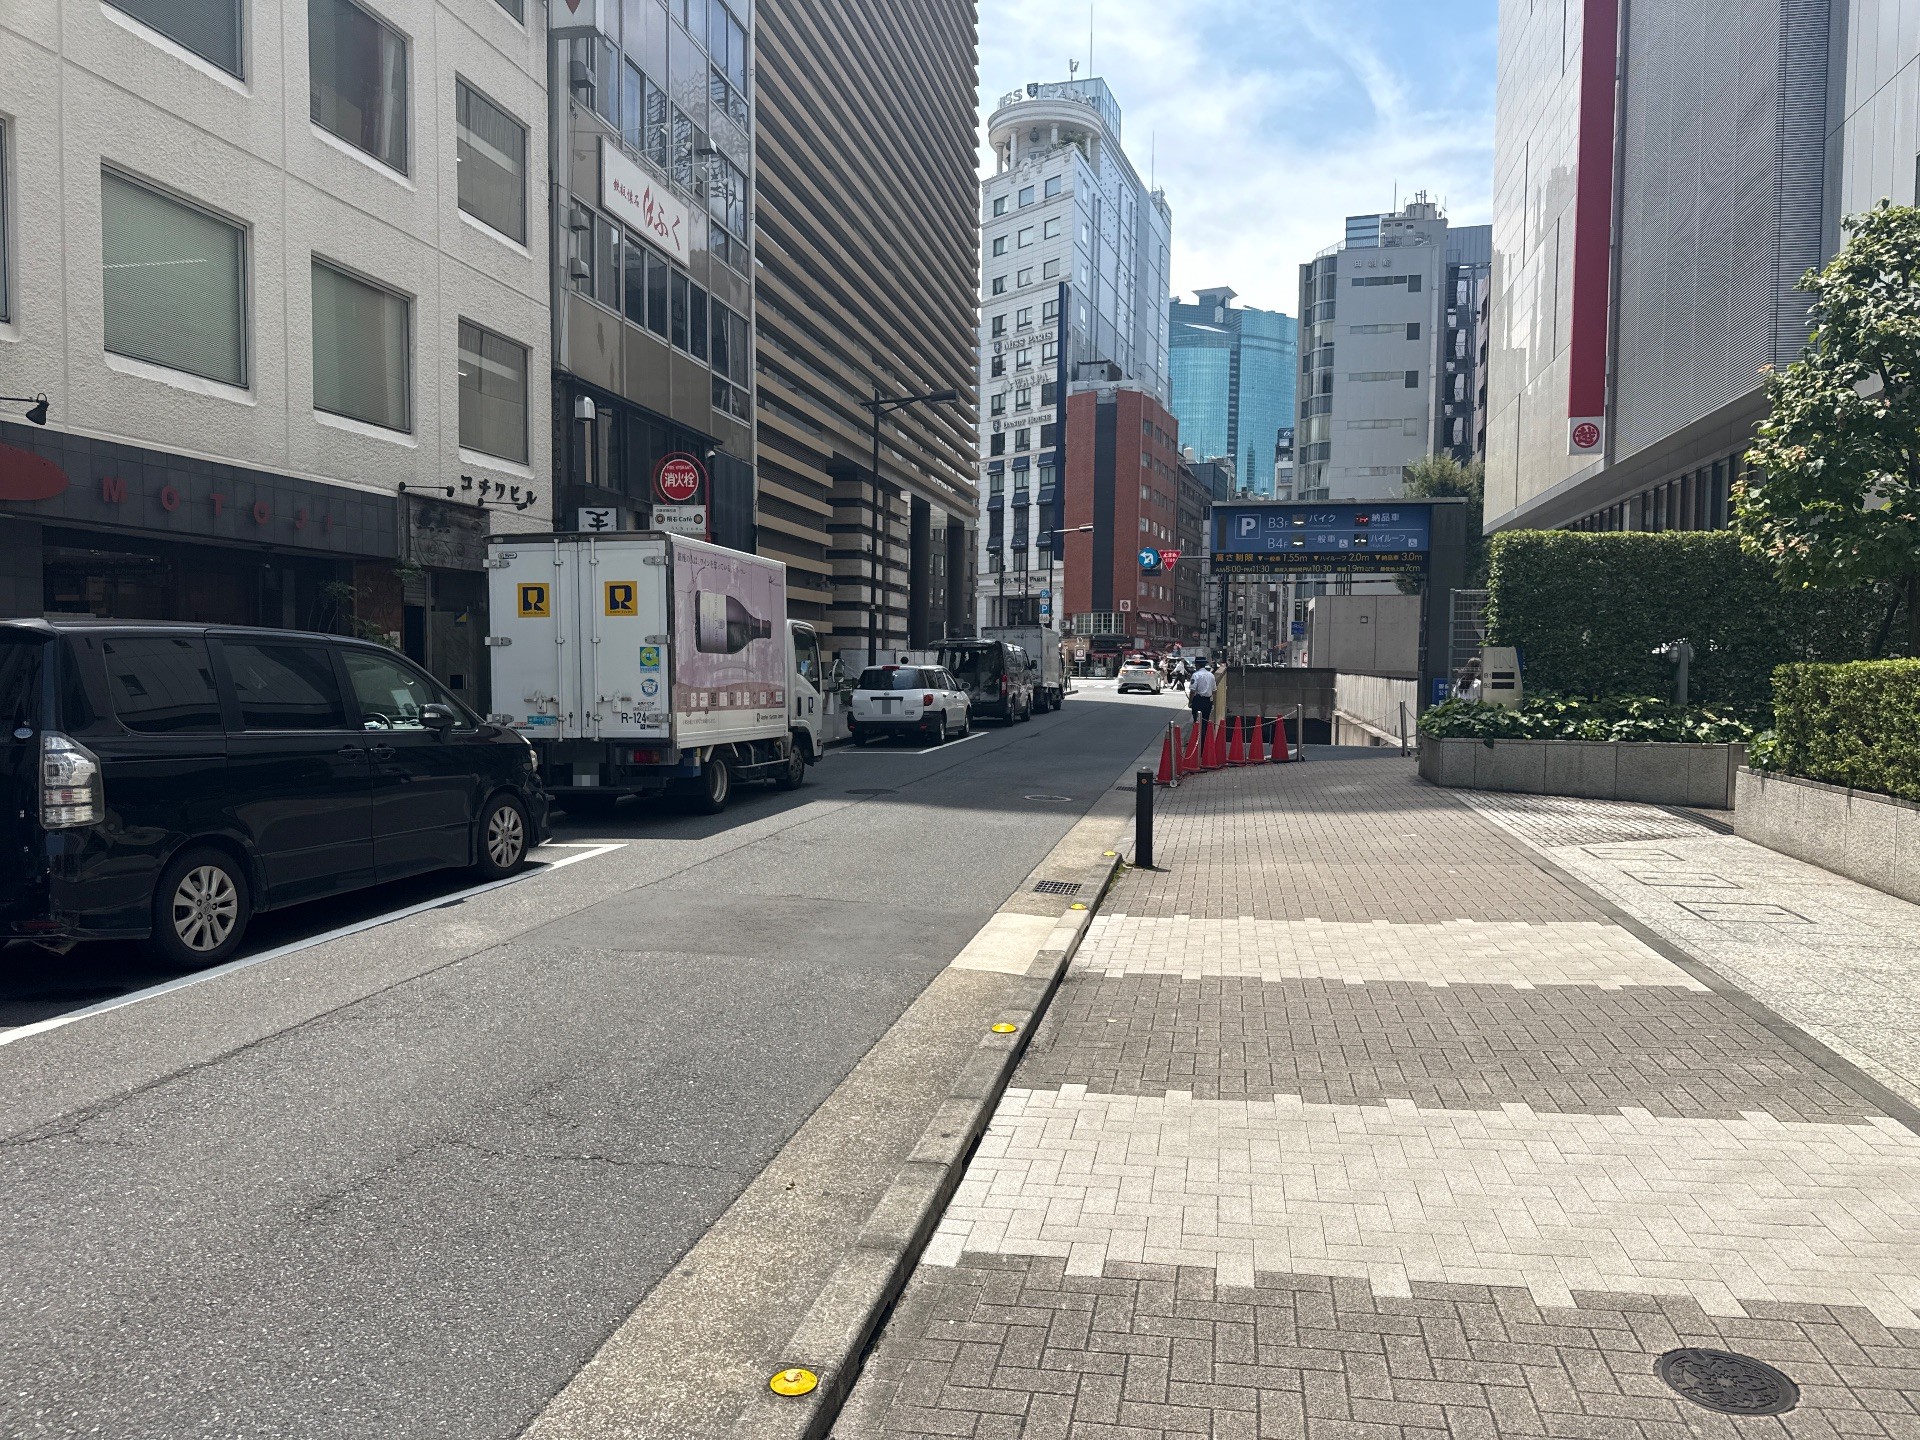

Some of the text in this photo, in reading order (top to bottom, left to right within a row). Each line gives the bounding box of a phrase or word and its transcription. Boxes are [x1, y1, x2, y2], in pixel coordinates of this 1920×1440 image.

[664, 472, 695, 488] 消火栓
[102, 475, 333, 536] MOTOJI
[1268, 517, 1289, 529] B3F
[1308, 514, 1336, 523] バイク
[1371, 513, 1400, 522] 納品車
[1240, 517, 1256, 537] P
[1266, 538, 1288, 549] B4F
[1309, 535, 1336, 544] 一般車
[1371, 534, 1406, 543] ハイルーフ
[1215, 554, 1254, 562] 高さ制限
[1283, 553, 1308, 562] 1.55m
[1348, 553, 1370, 561] 2.0m
[1401, 552, 1423, 561] 3.0m
[522, 587, 545, 611] R
[609, 585, 633, 610] R
[1041, 604, 1048, 615] P
[1494, 651, 1514, 669] IN
[621, 711, 647, 724] R-124
